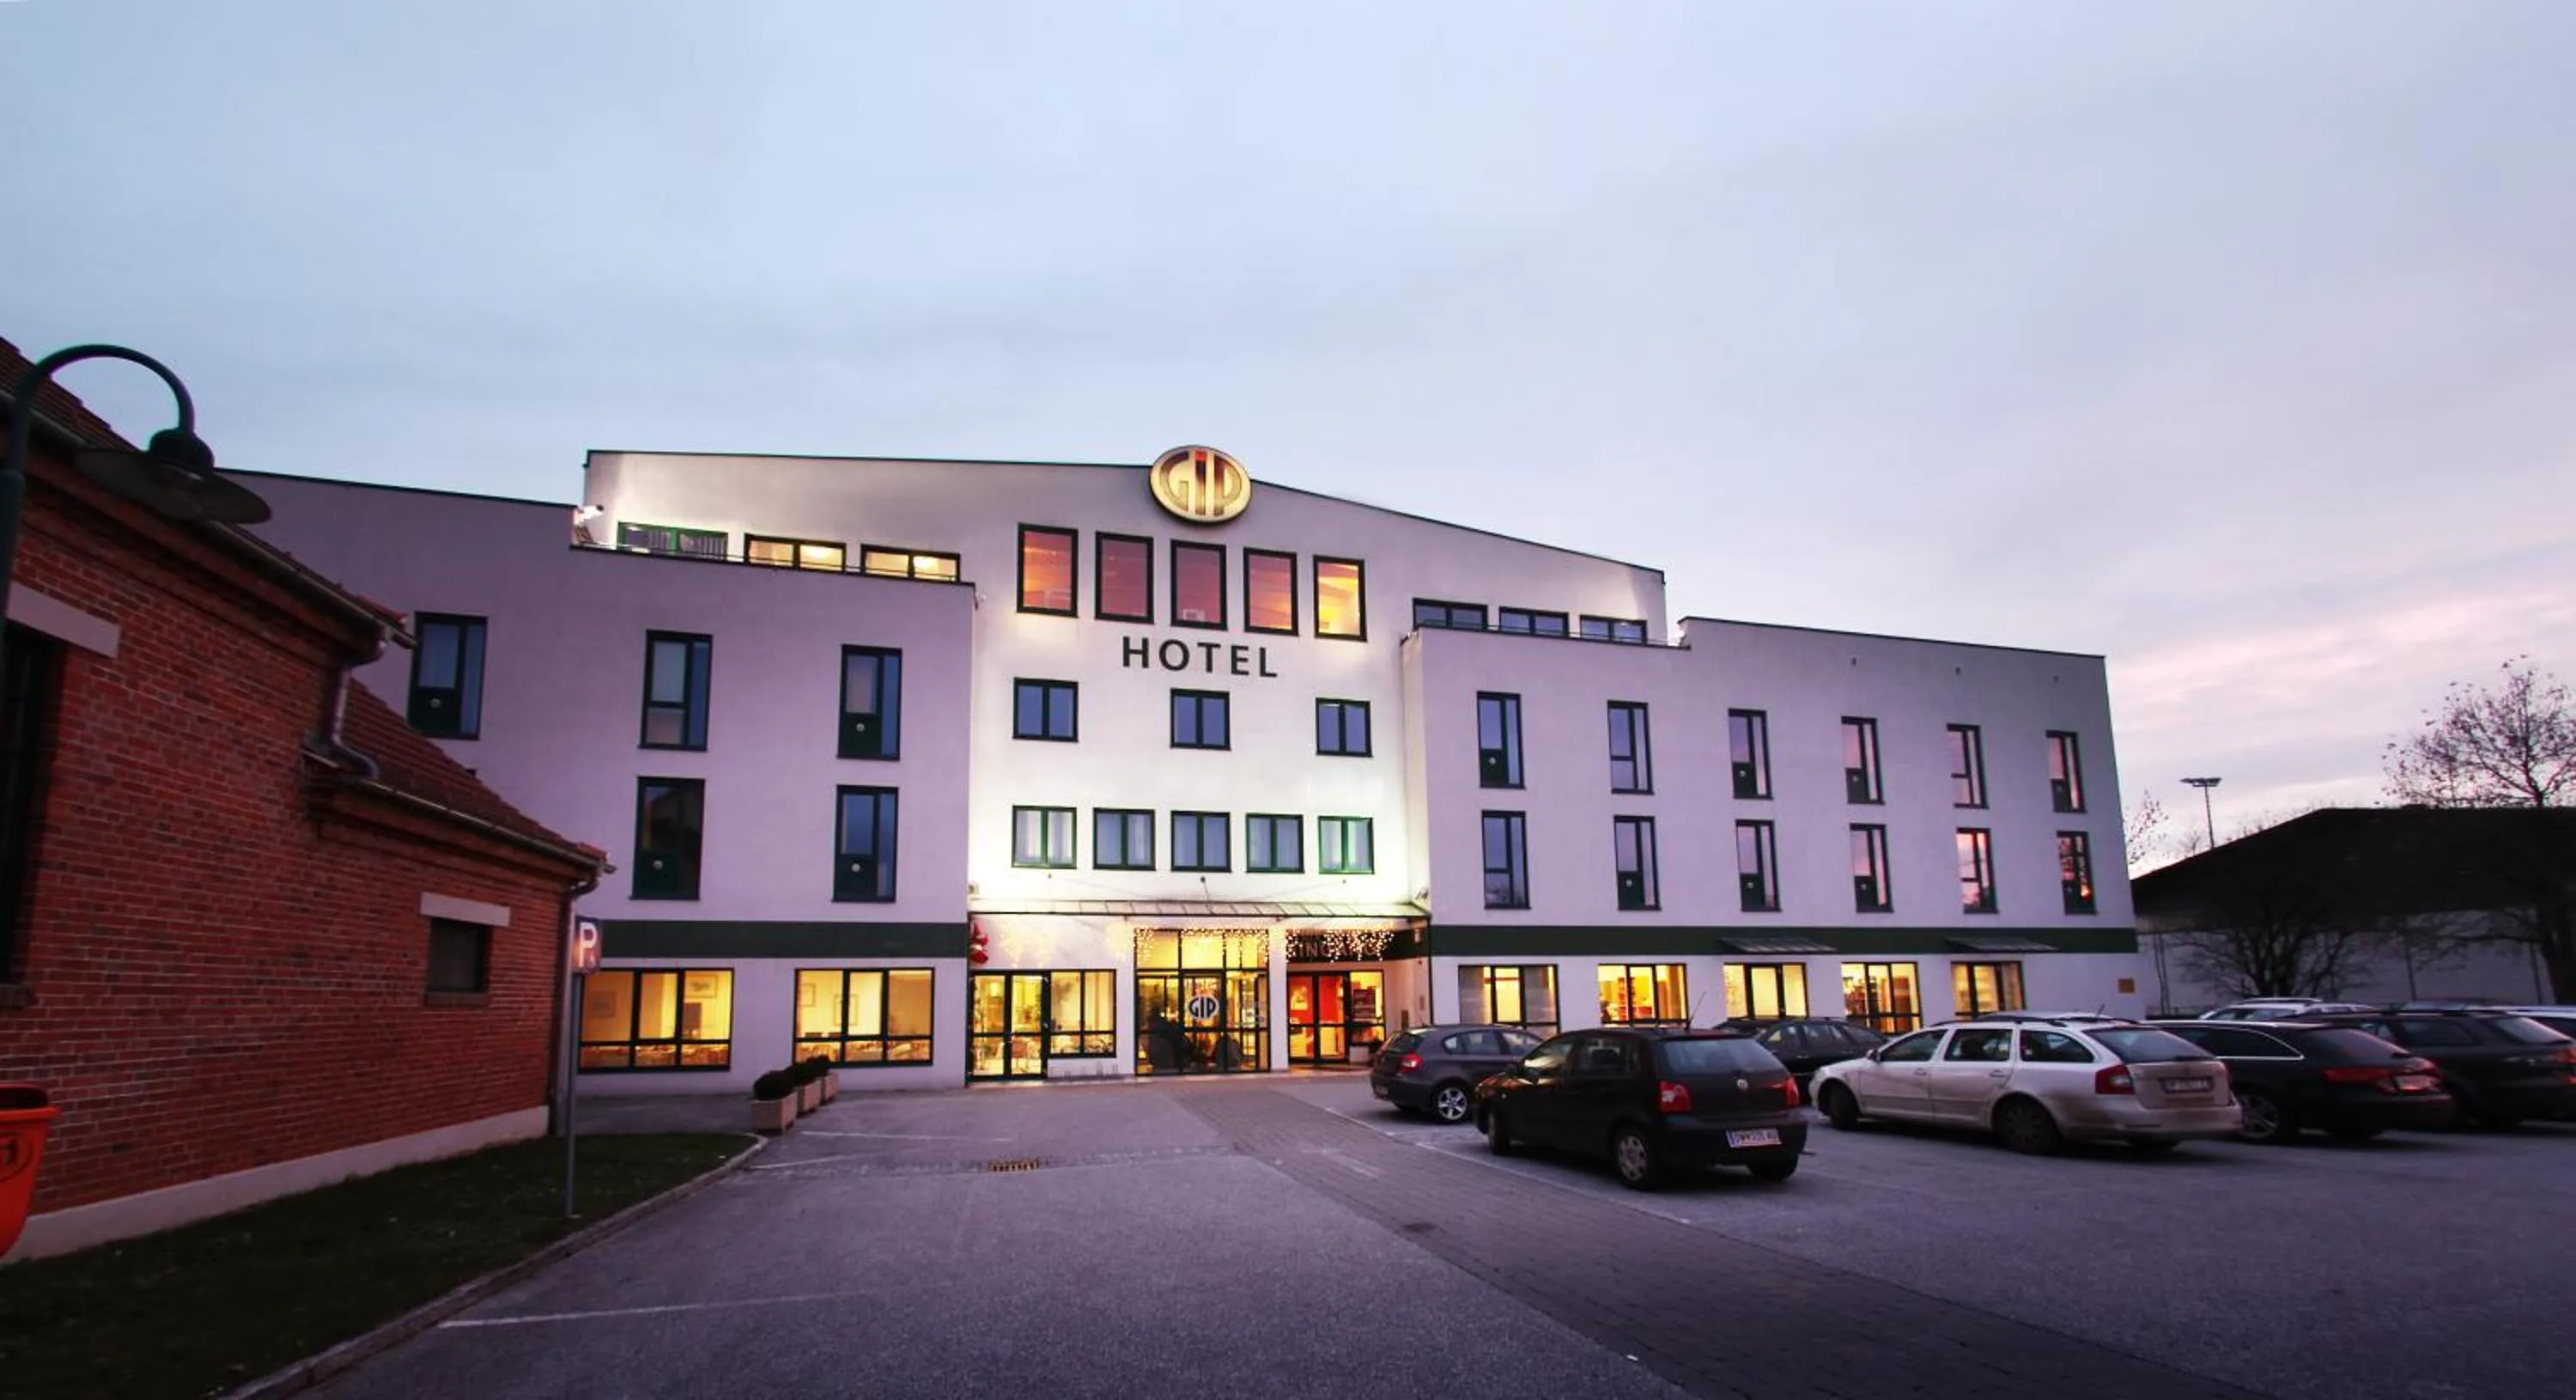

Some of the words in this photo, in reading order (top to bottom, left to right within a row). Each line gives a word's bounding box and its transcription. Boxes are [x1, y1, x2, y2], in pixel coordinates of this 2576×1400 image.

[1158, 449, 1242, 516] GIP
[1122, 636, 1278, 678] HOTEL
[579, 922, 598, 967] P
[1188, 996, 1217, 1018] GIP
